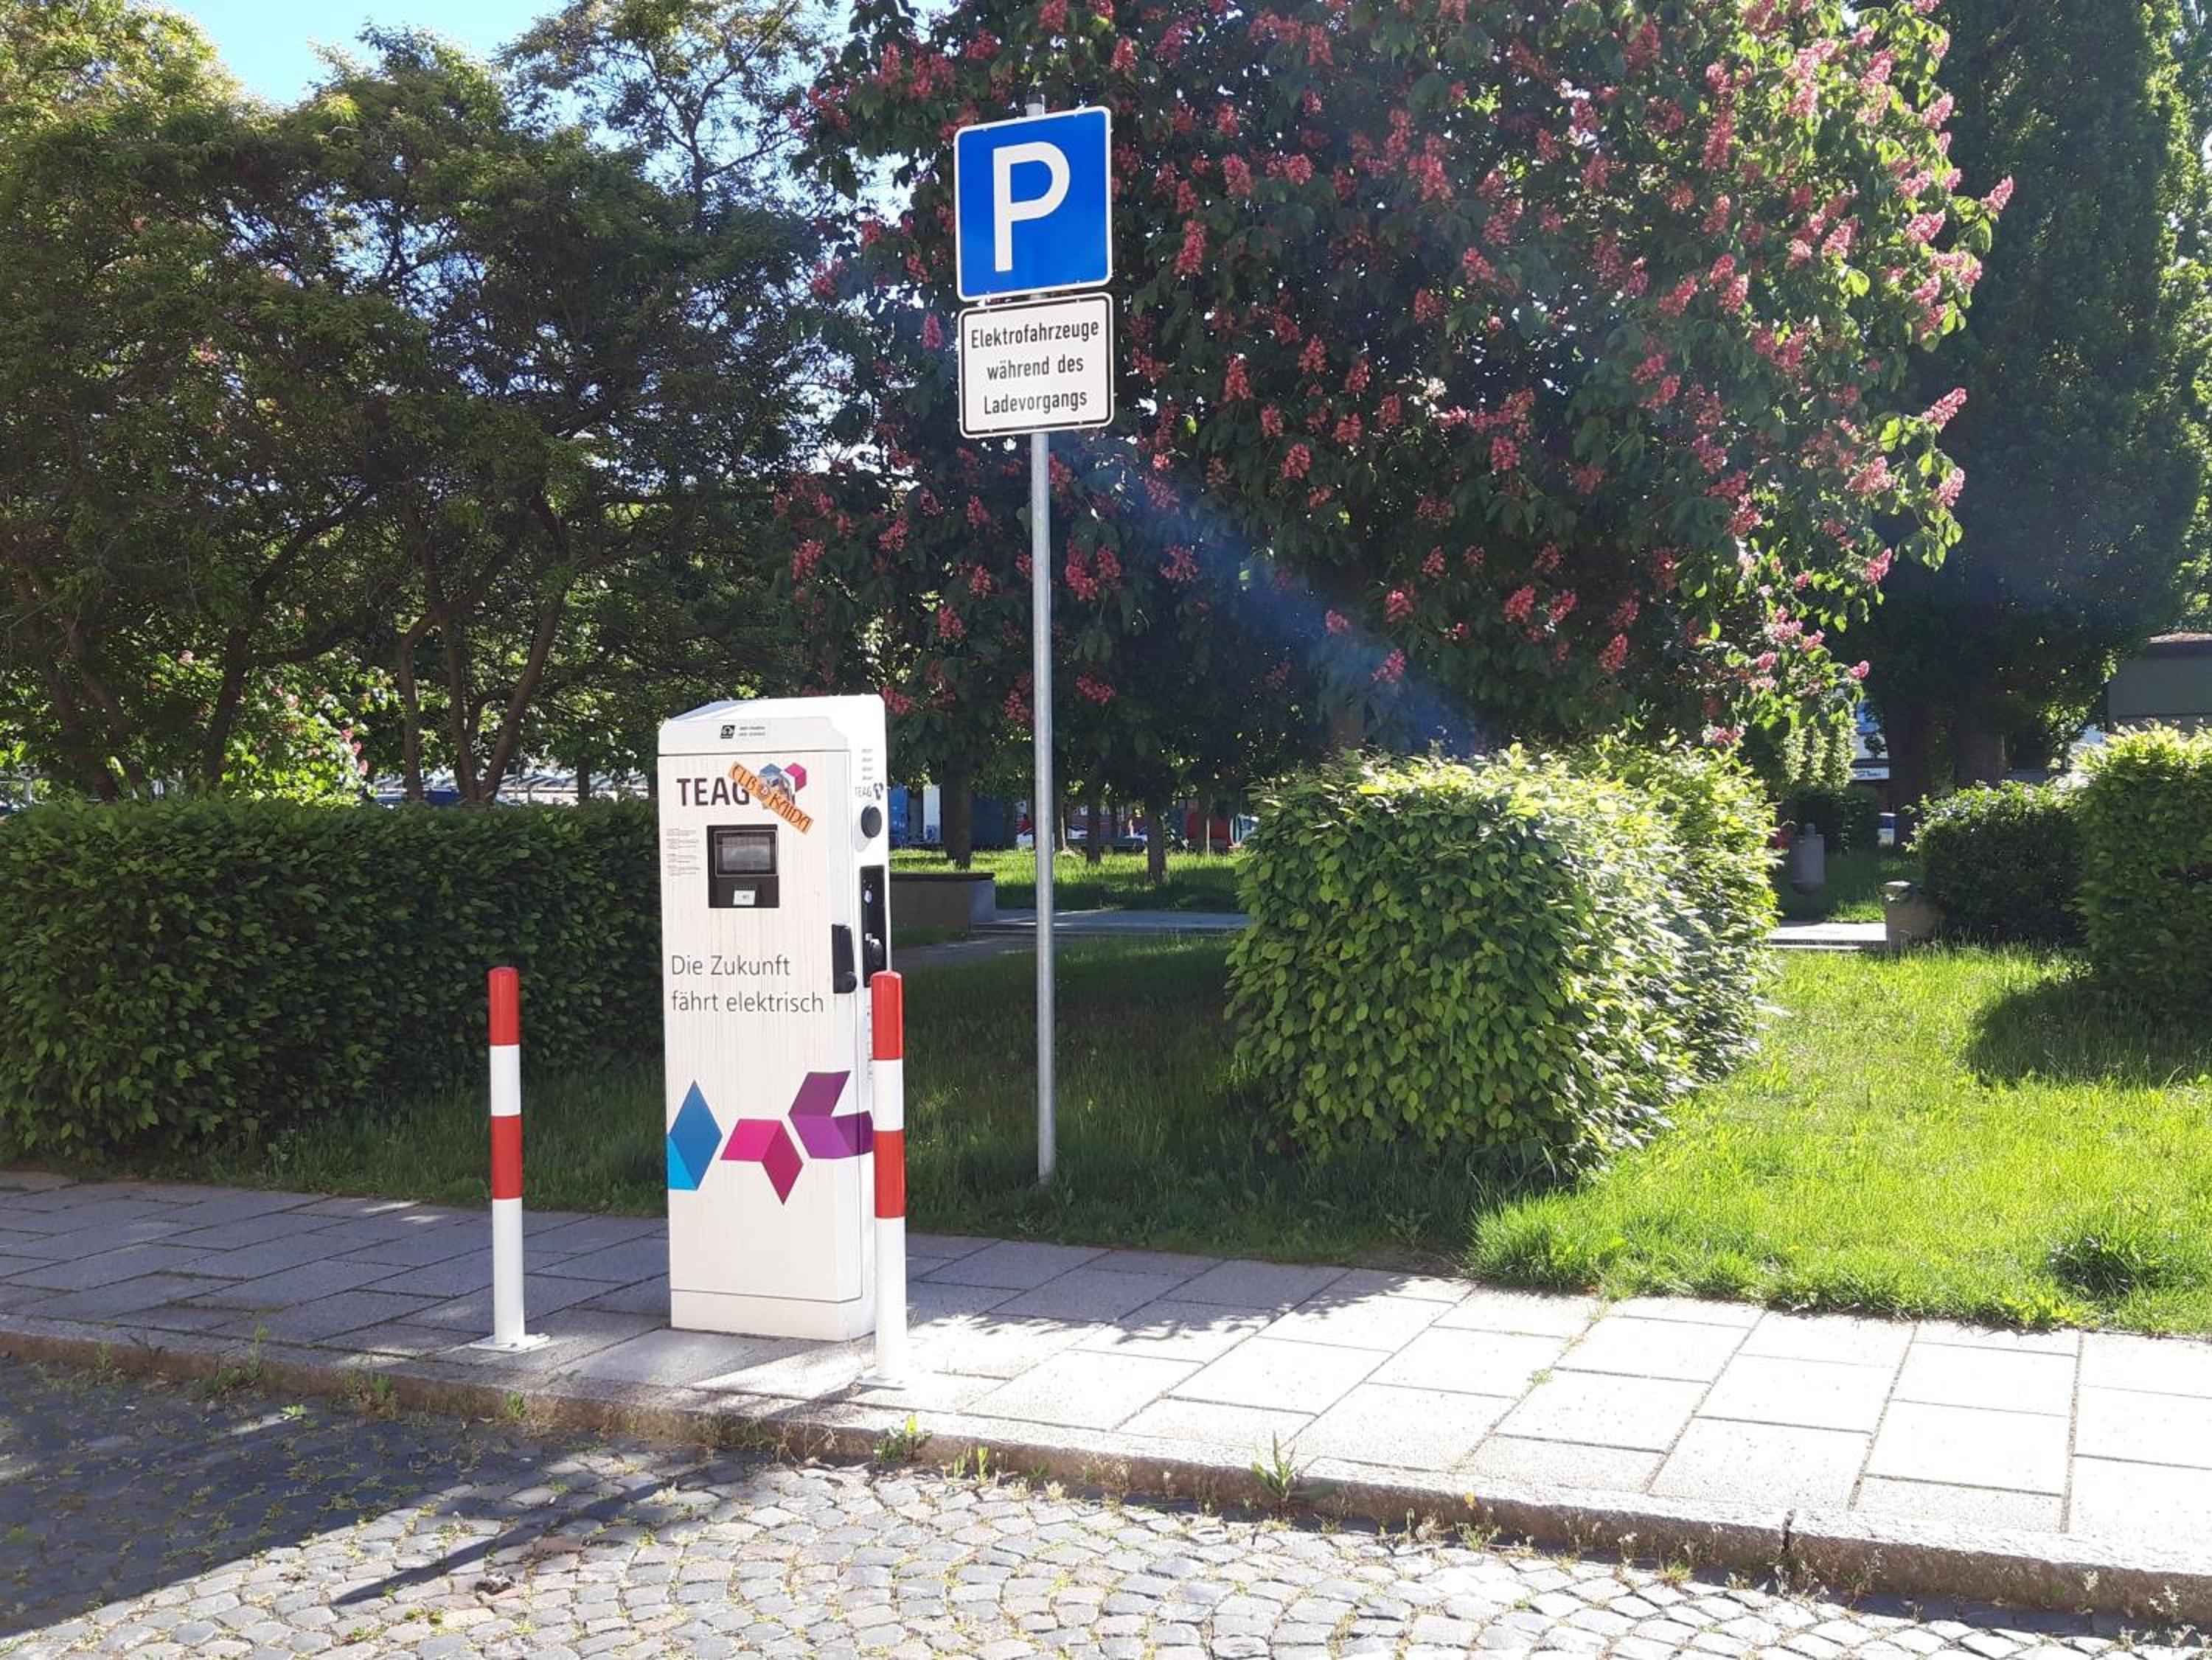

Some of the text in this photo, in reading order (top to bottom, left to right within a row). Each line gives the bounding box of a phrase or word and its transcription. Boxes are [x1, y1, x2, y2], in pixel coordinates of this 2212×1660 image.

[993, 142, 1070, 272] P
[971, 321, 1099, 349] Elektrofahrzeuge
[987, 354, 1084, 380] während des
[984, 391, 1088, 414] Ladevorgangs
[676, 777, 750, 806] TEAG
[671, 955, 790, 976] Die Zukunft
[672, 990, 824, 1014] fährt elektrisch
